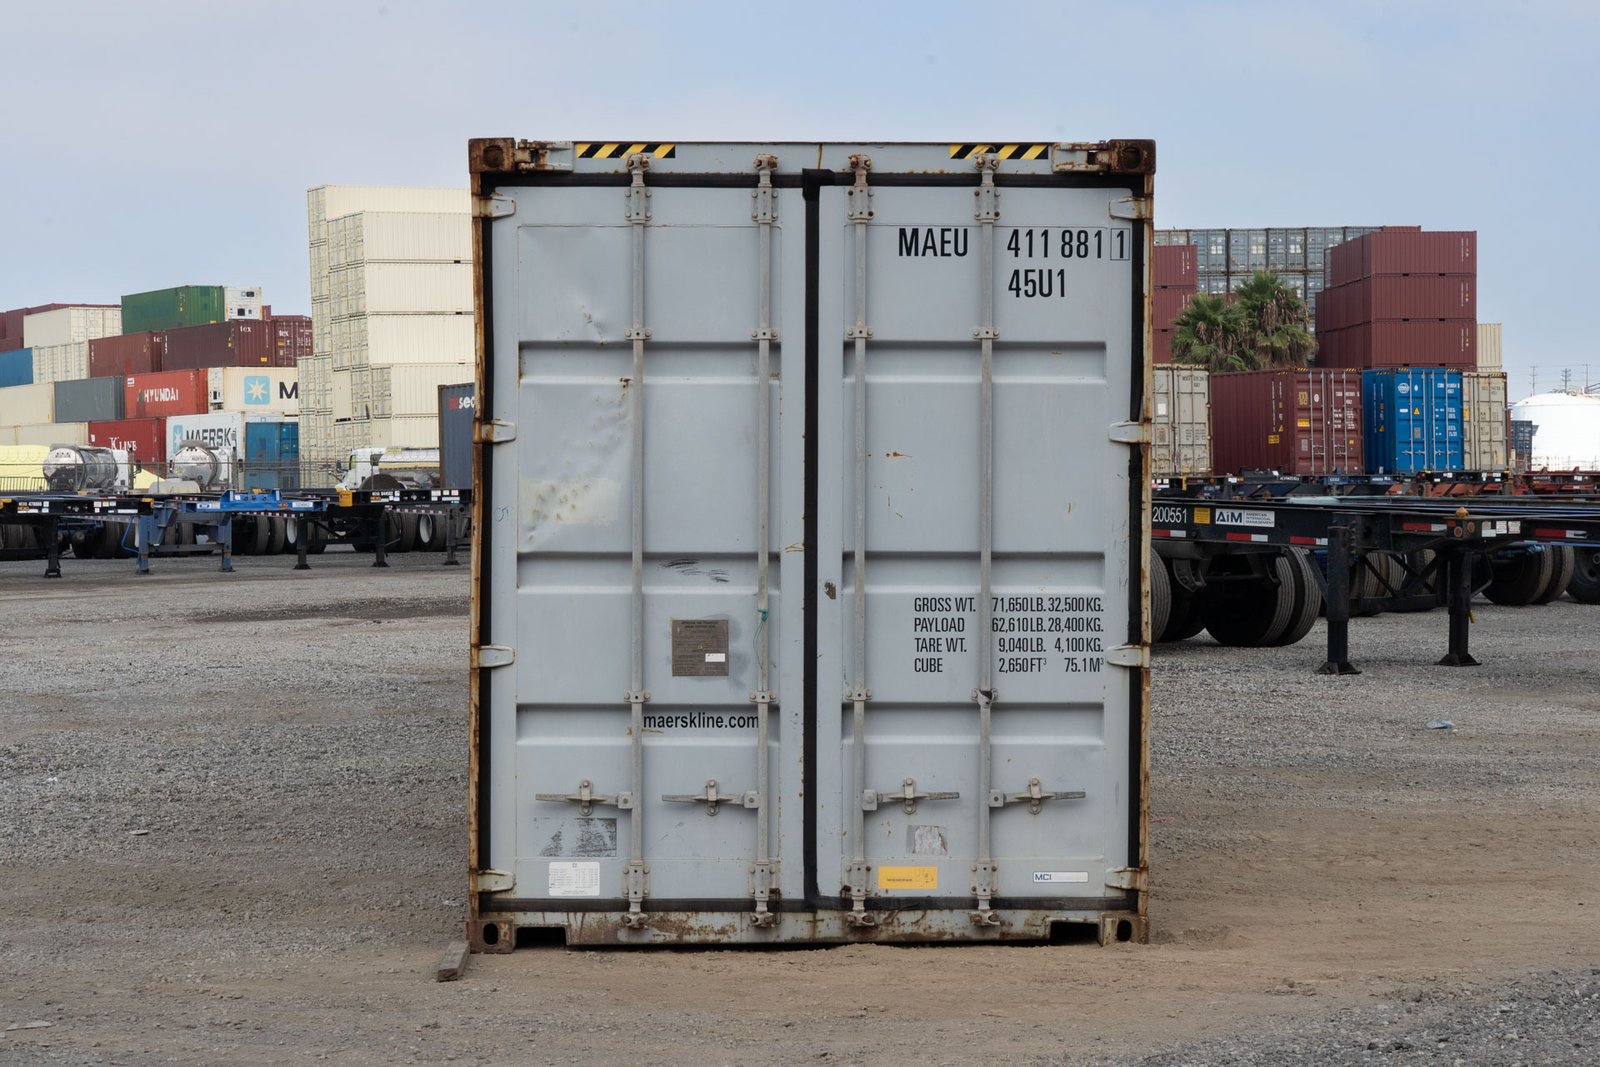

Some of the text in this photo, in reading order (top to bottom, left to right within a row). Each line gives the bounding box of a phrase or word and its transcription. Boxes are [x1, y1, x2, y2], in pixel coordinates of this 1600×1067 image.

[899, 228, 1124, 259] MAEU 411 881 1
[1008, 269, 1065, 298] 45U1
[144, 387, 179, 403] HYUNDAI
[1152, 506, 1187, 524] 200551
[914, 597, 951, 612] GROSS
[955, 597, 976, 612] WT.
[914, 618, 964, 632] PAYLOAD
[915, 638, 942, 652] TARE
[946, 638, 967, 652] WT.
[915, 658, 943, 672] CUBE
[643, 712, 758, 728] maerskline.com
